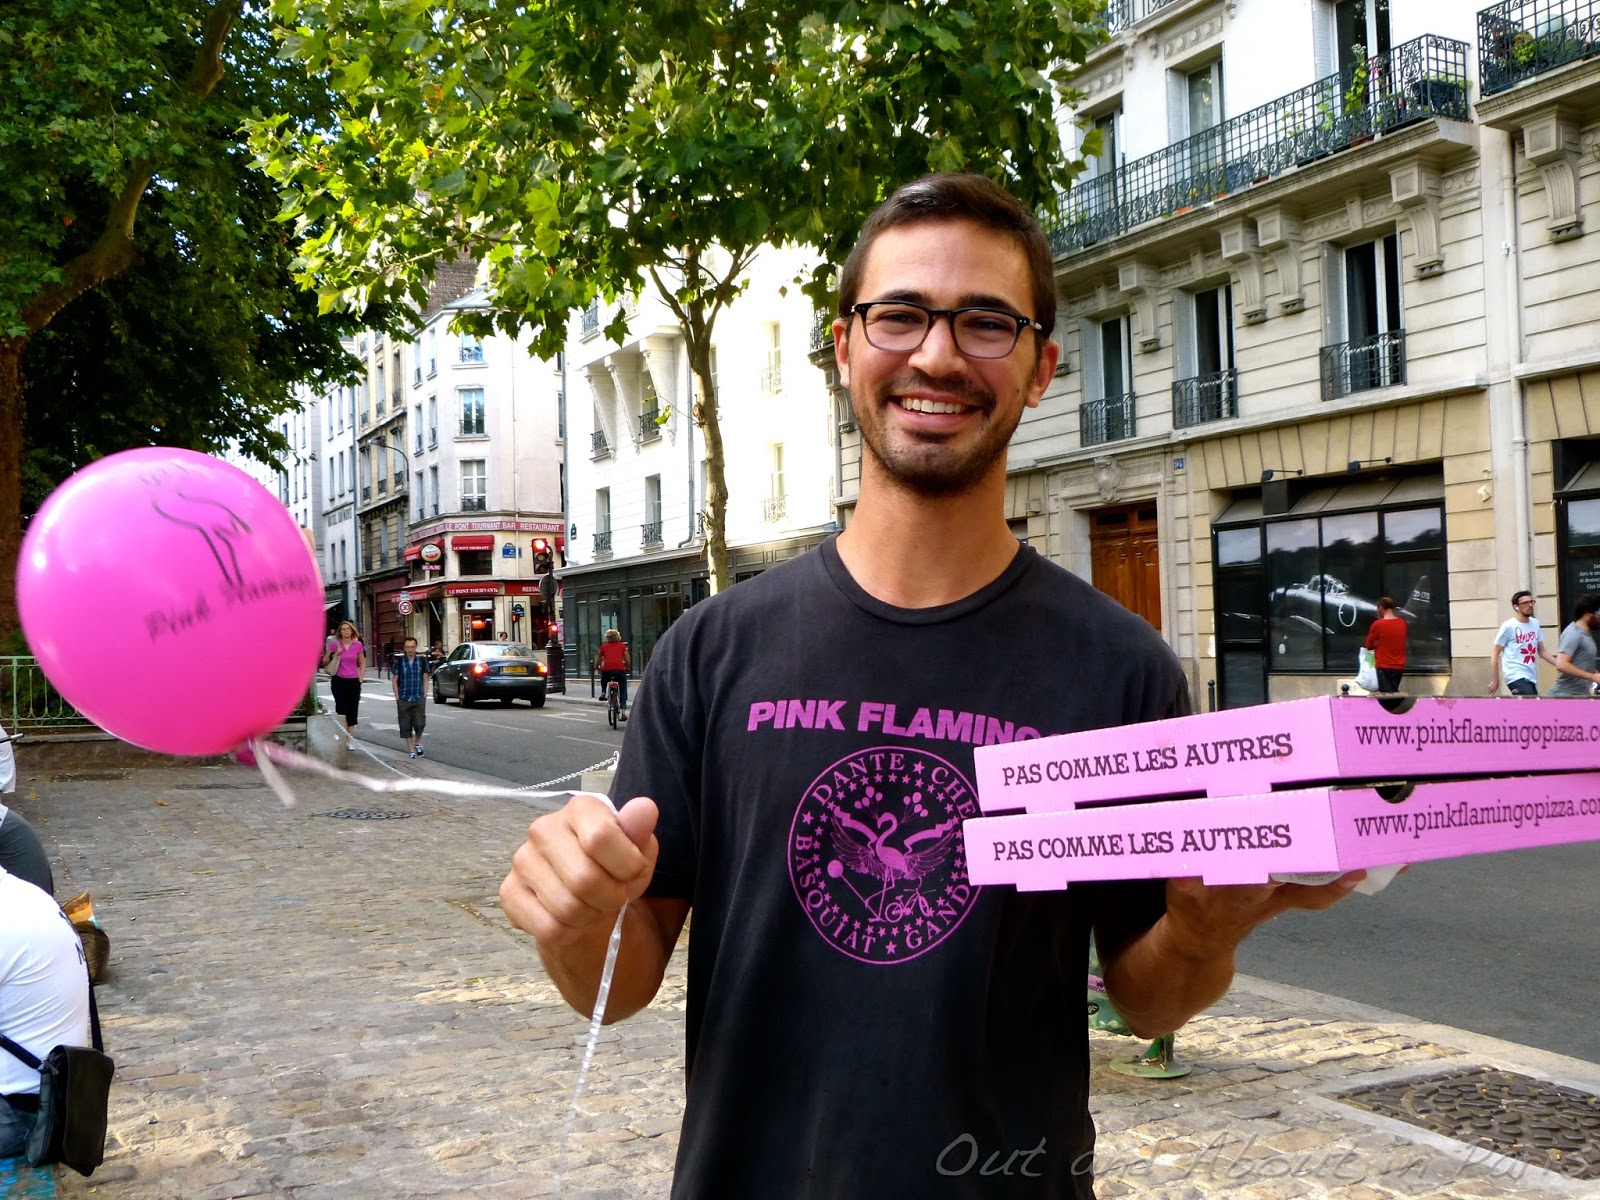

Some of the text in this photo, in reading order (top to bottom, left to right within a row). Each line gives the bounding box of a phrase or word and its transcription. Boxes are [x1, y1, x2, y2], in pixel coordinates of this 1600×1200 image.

[472, 522, 501, 530] TOURNANT
[520, 523, 560, 531] RESTAURANT
[747, 699, 847, 731] PINK
[1355, 718, 1600, 751] www.pinkflamingopizza.c
[812, 753, 905, 805] DANTE
[1002, 733, 1293, 786] PAS COMME LES AUTRES
[931, 766, 977, 819] CHE
[993, 824, 1292, 861] PAS COMME LES AUTRES
[795, 835, 876, 954] BASQUIAT
